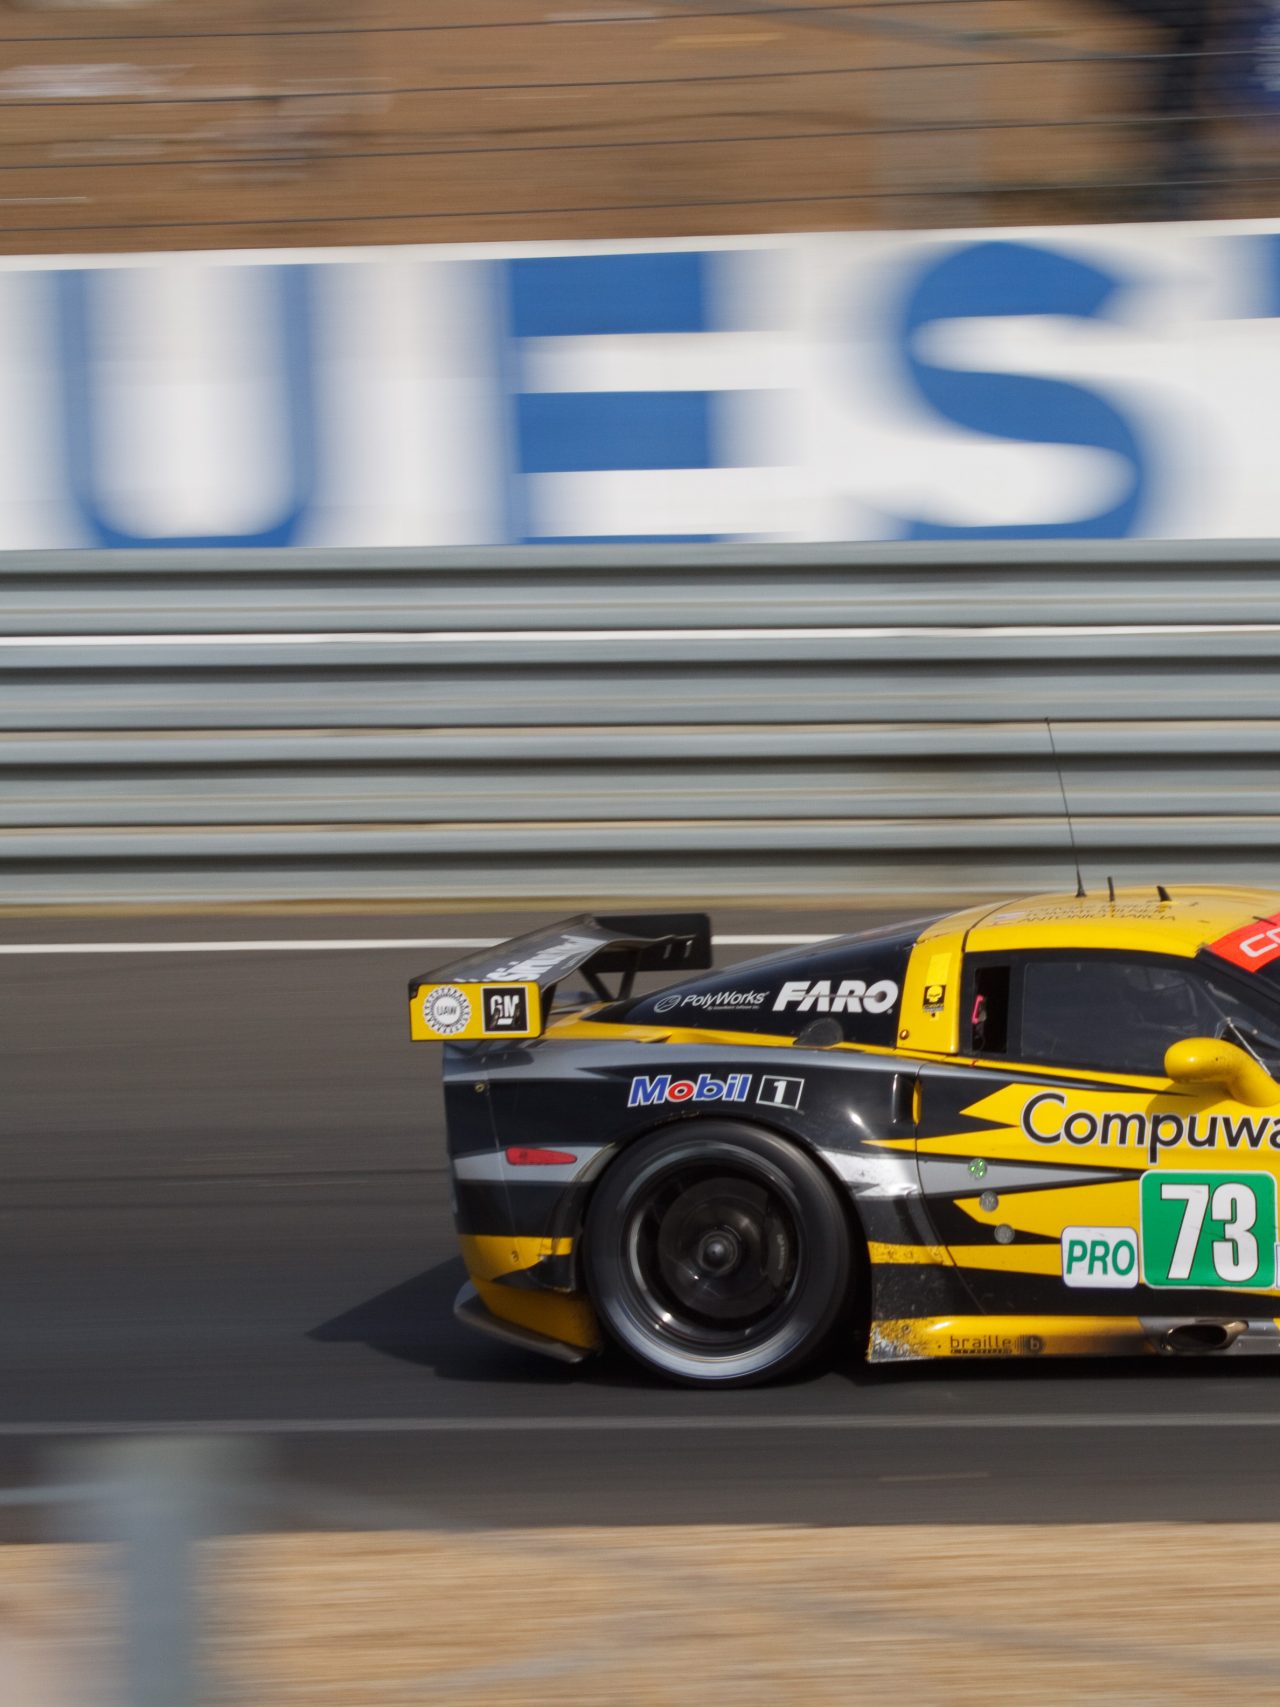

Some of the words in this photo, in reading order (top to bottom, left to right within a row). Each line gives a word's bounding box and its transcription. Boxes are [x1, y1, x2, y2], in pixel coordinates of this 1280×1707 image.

[490, 995, 519, 1017] GM
[680, 991, 765, 1009] PolyWorks
[772, 979, 899, 1014] FARO
[627, 1074, 753, 1107] Mobil
[1160, 1182, 1260, 1282] 73
[1066, 1239, 1135, 1276] PRO
[950, 1335, 1011, 1349] braille
